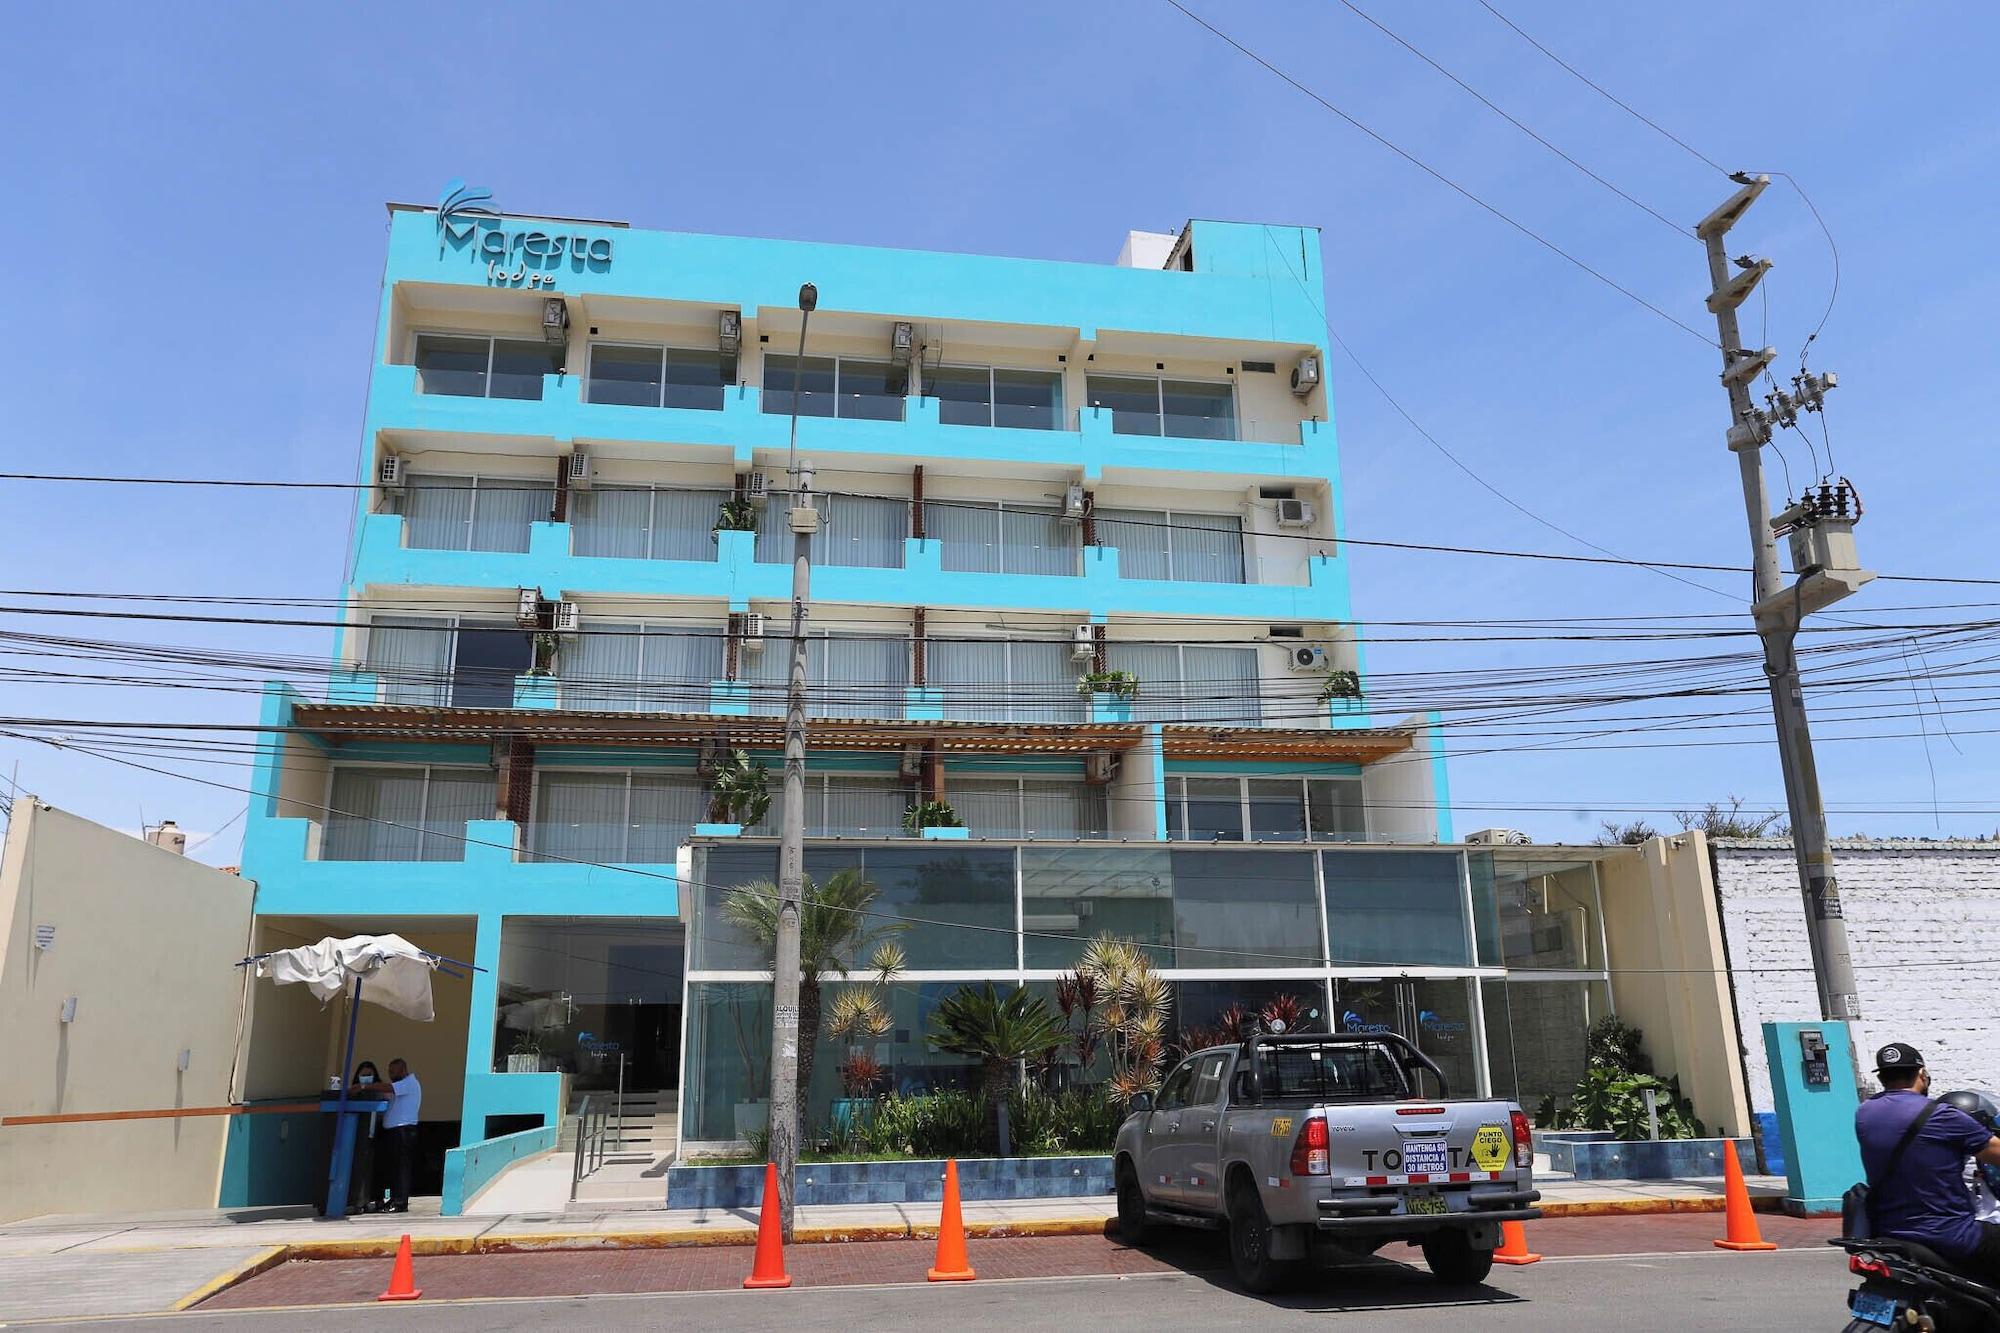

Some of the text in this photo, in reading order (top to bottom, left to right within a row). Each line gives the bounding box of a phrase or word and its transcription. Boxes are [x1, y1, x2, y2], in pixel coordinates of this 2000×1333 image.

[439, 219, 613, 262] Maresta
[487, 259, 556, 289] lodge
[1347, 1023, 1391, 1033] Maresta
[1424, 1022, 1466, 1032] Maresta
[1405, 1142, 1445, 1153] MANTENGA SU
[1405, 1153, 1446, 1163] DISTANCIA A
[1407, 1162, 1444, 1172] 30 METROS
